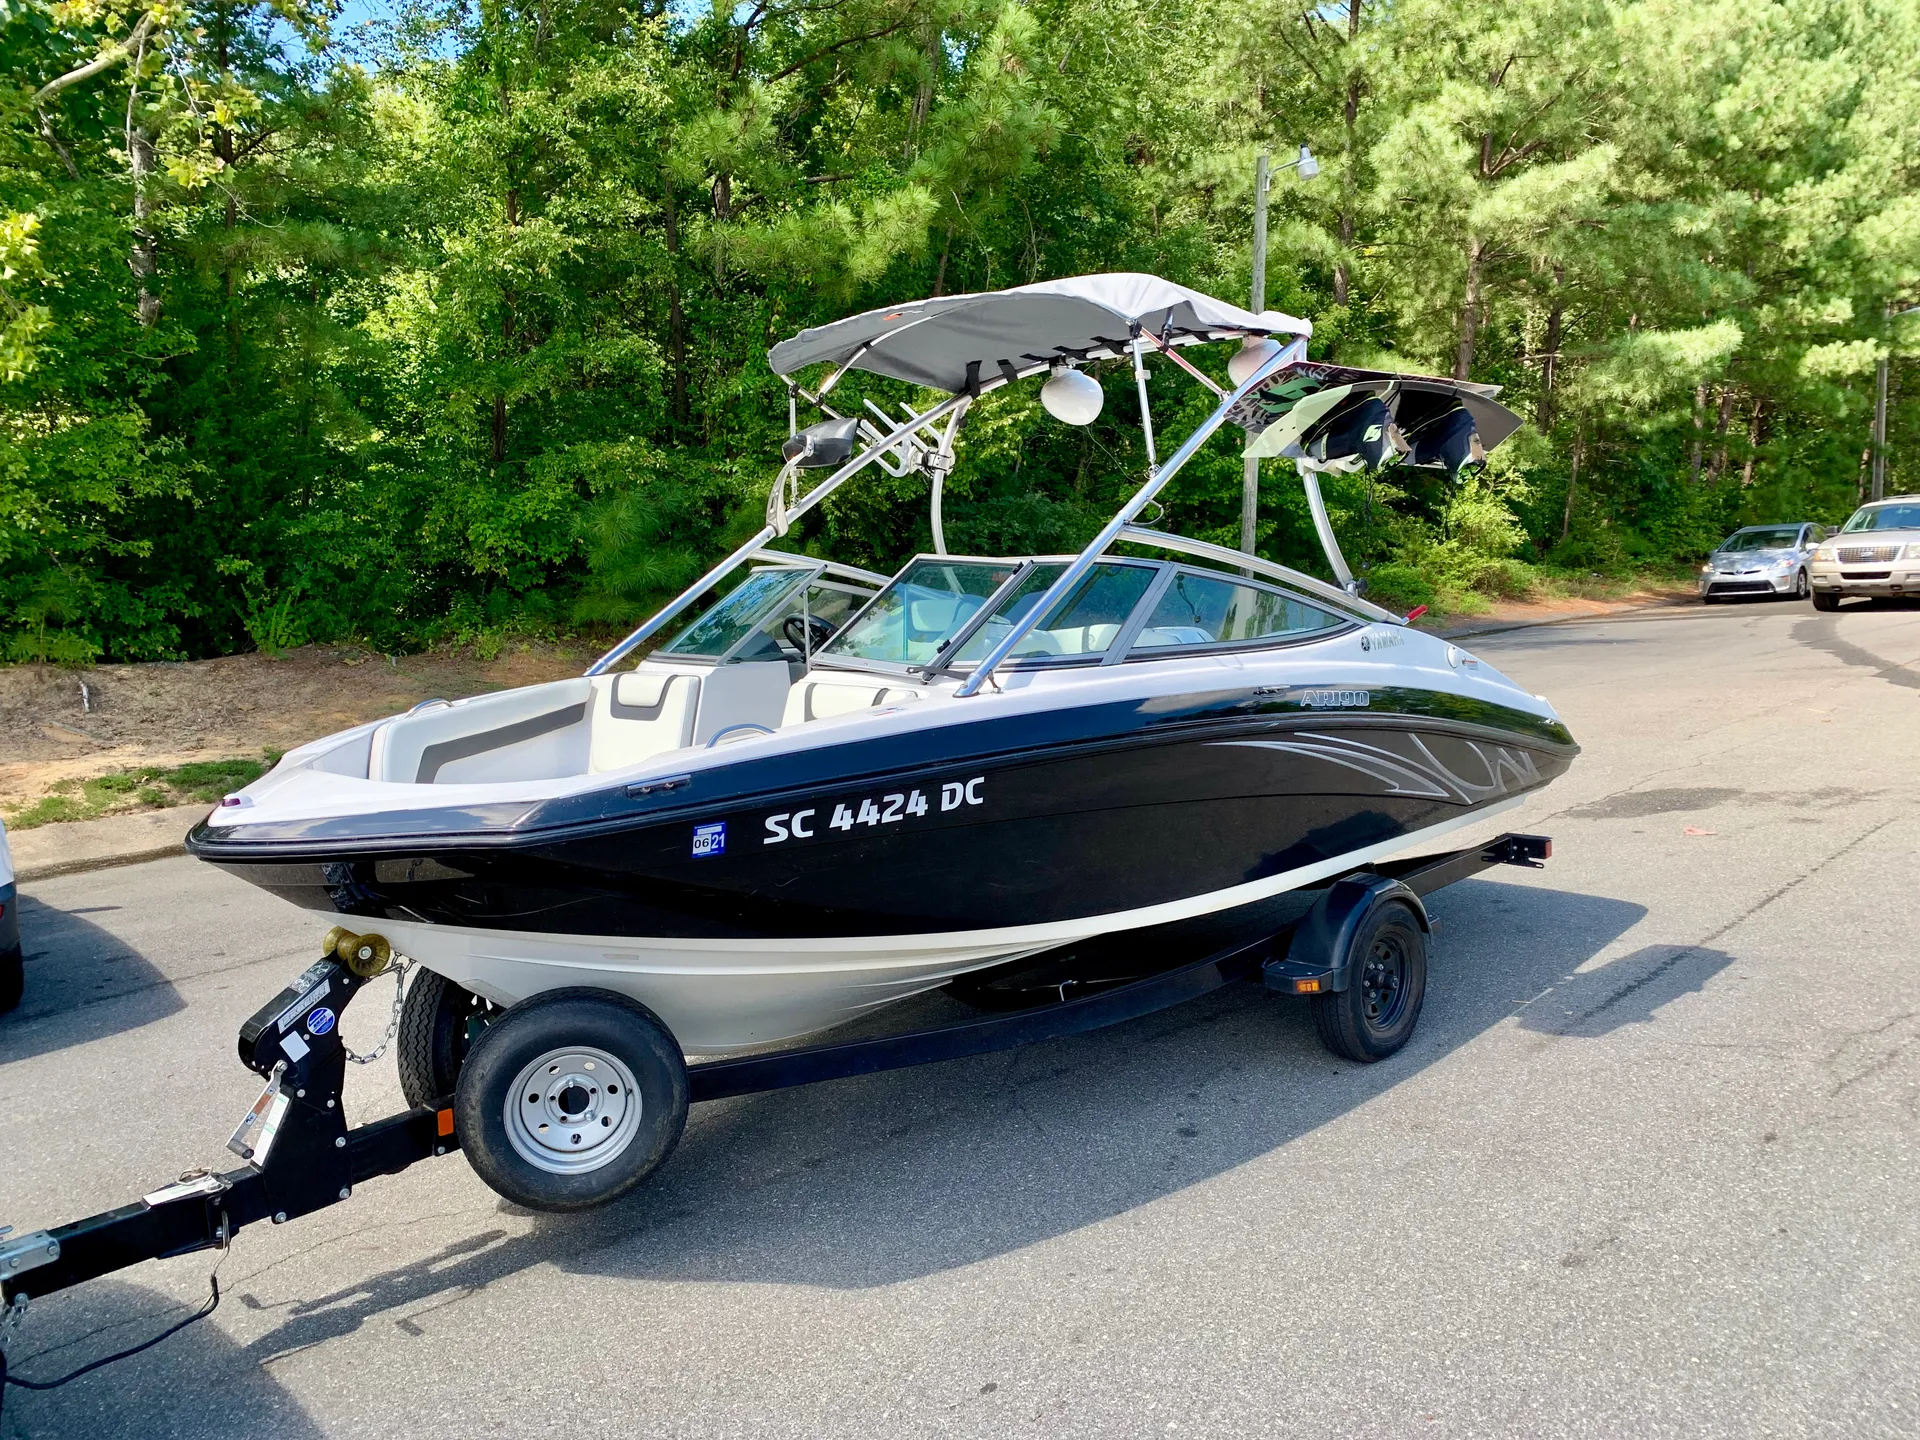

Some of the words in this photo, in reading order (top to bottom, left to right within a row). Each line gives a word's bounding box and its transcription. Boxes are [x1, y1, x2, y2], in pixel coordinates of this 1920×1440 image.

[1371, 629, 1405, 651] YAMAHA
[1300, 690, 1369, 707] AR190
[763, 809, 815, 845] SC
[829, 790, 928, 830] 4424
[941, 777, 985, 811] DC
[694, 838, 709, 849] 06
[711, 833, 725, 849] 21
